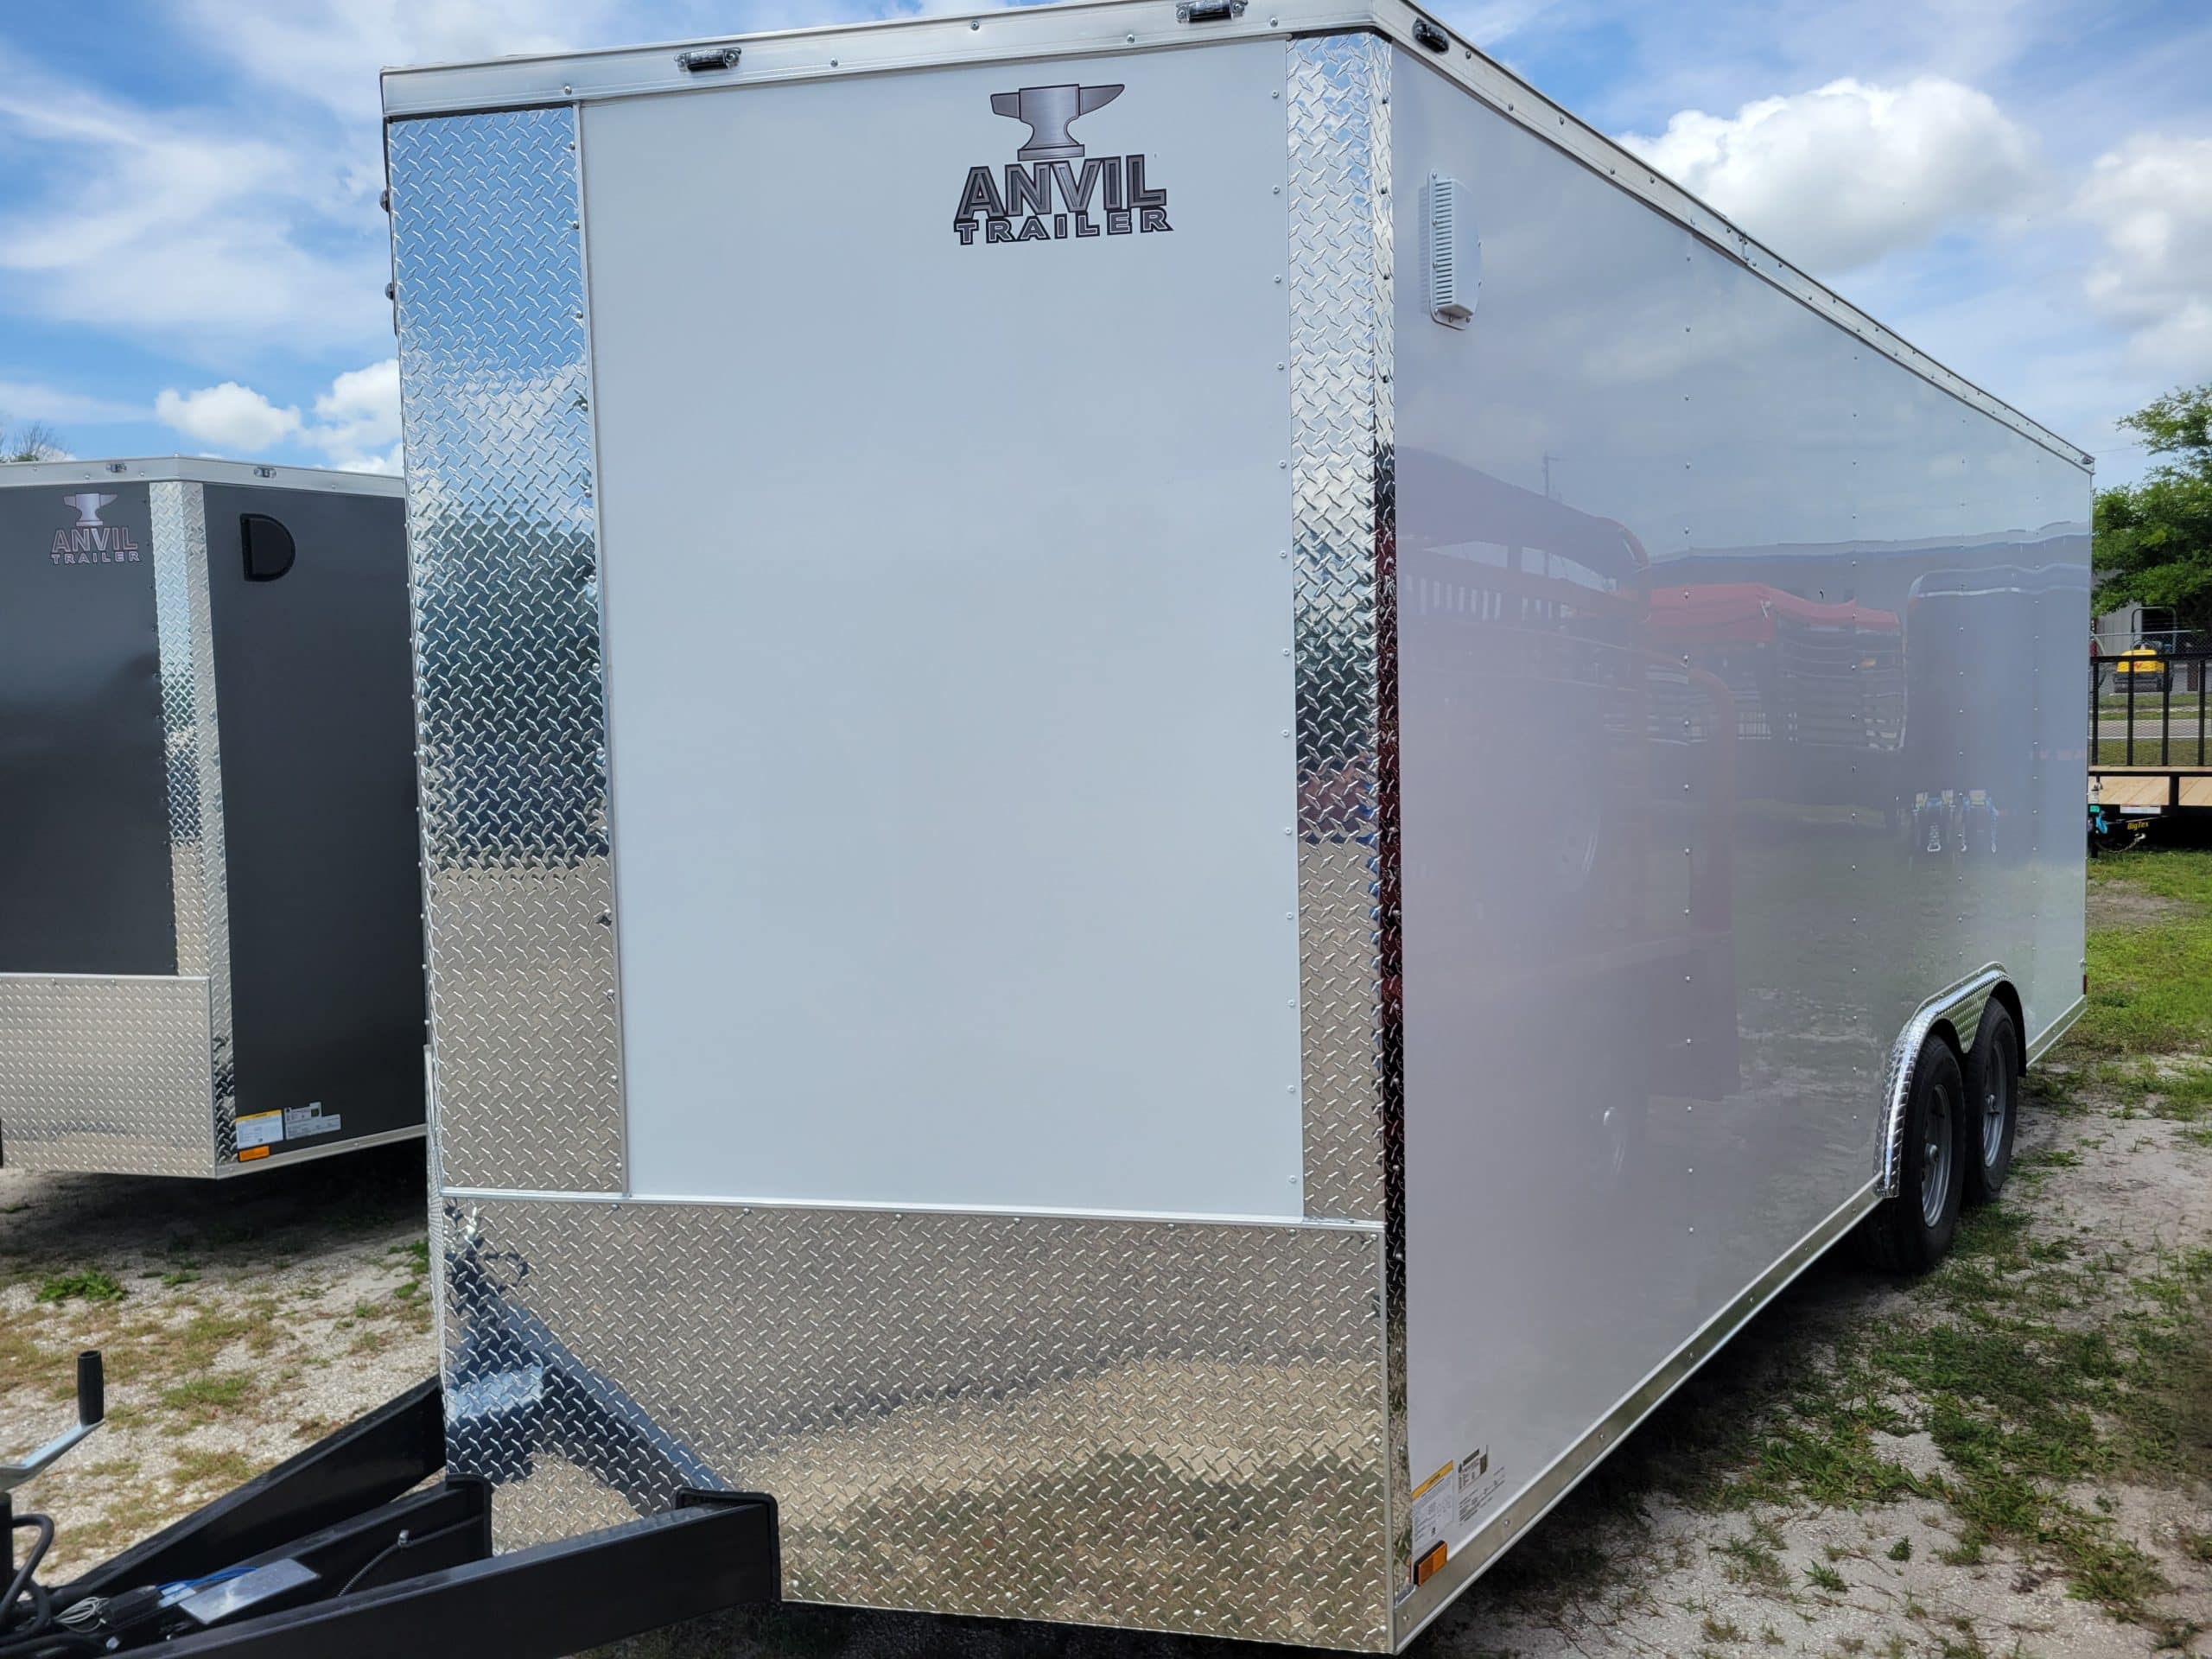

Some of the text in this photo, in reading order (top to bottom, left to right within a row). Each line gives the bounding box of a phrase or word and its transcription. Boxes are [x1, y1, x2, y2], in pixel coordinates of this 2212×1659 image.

[956, 154, 1166, 219] ANVIL
[954, 207, 1173, 245] TRAILER
[52, 527, 138, 553] ANVIL
[51, 550, 141, 564] TRAILER
